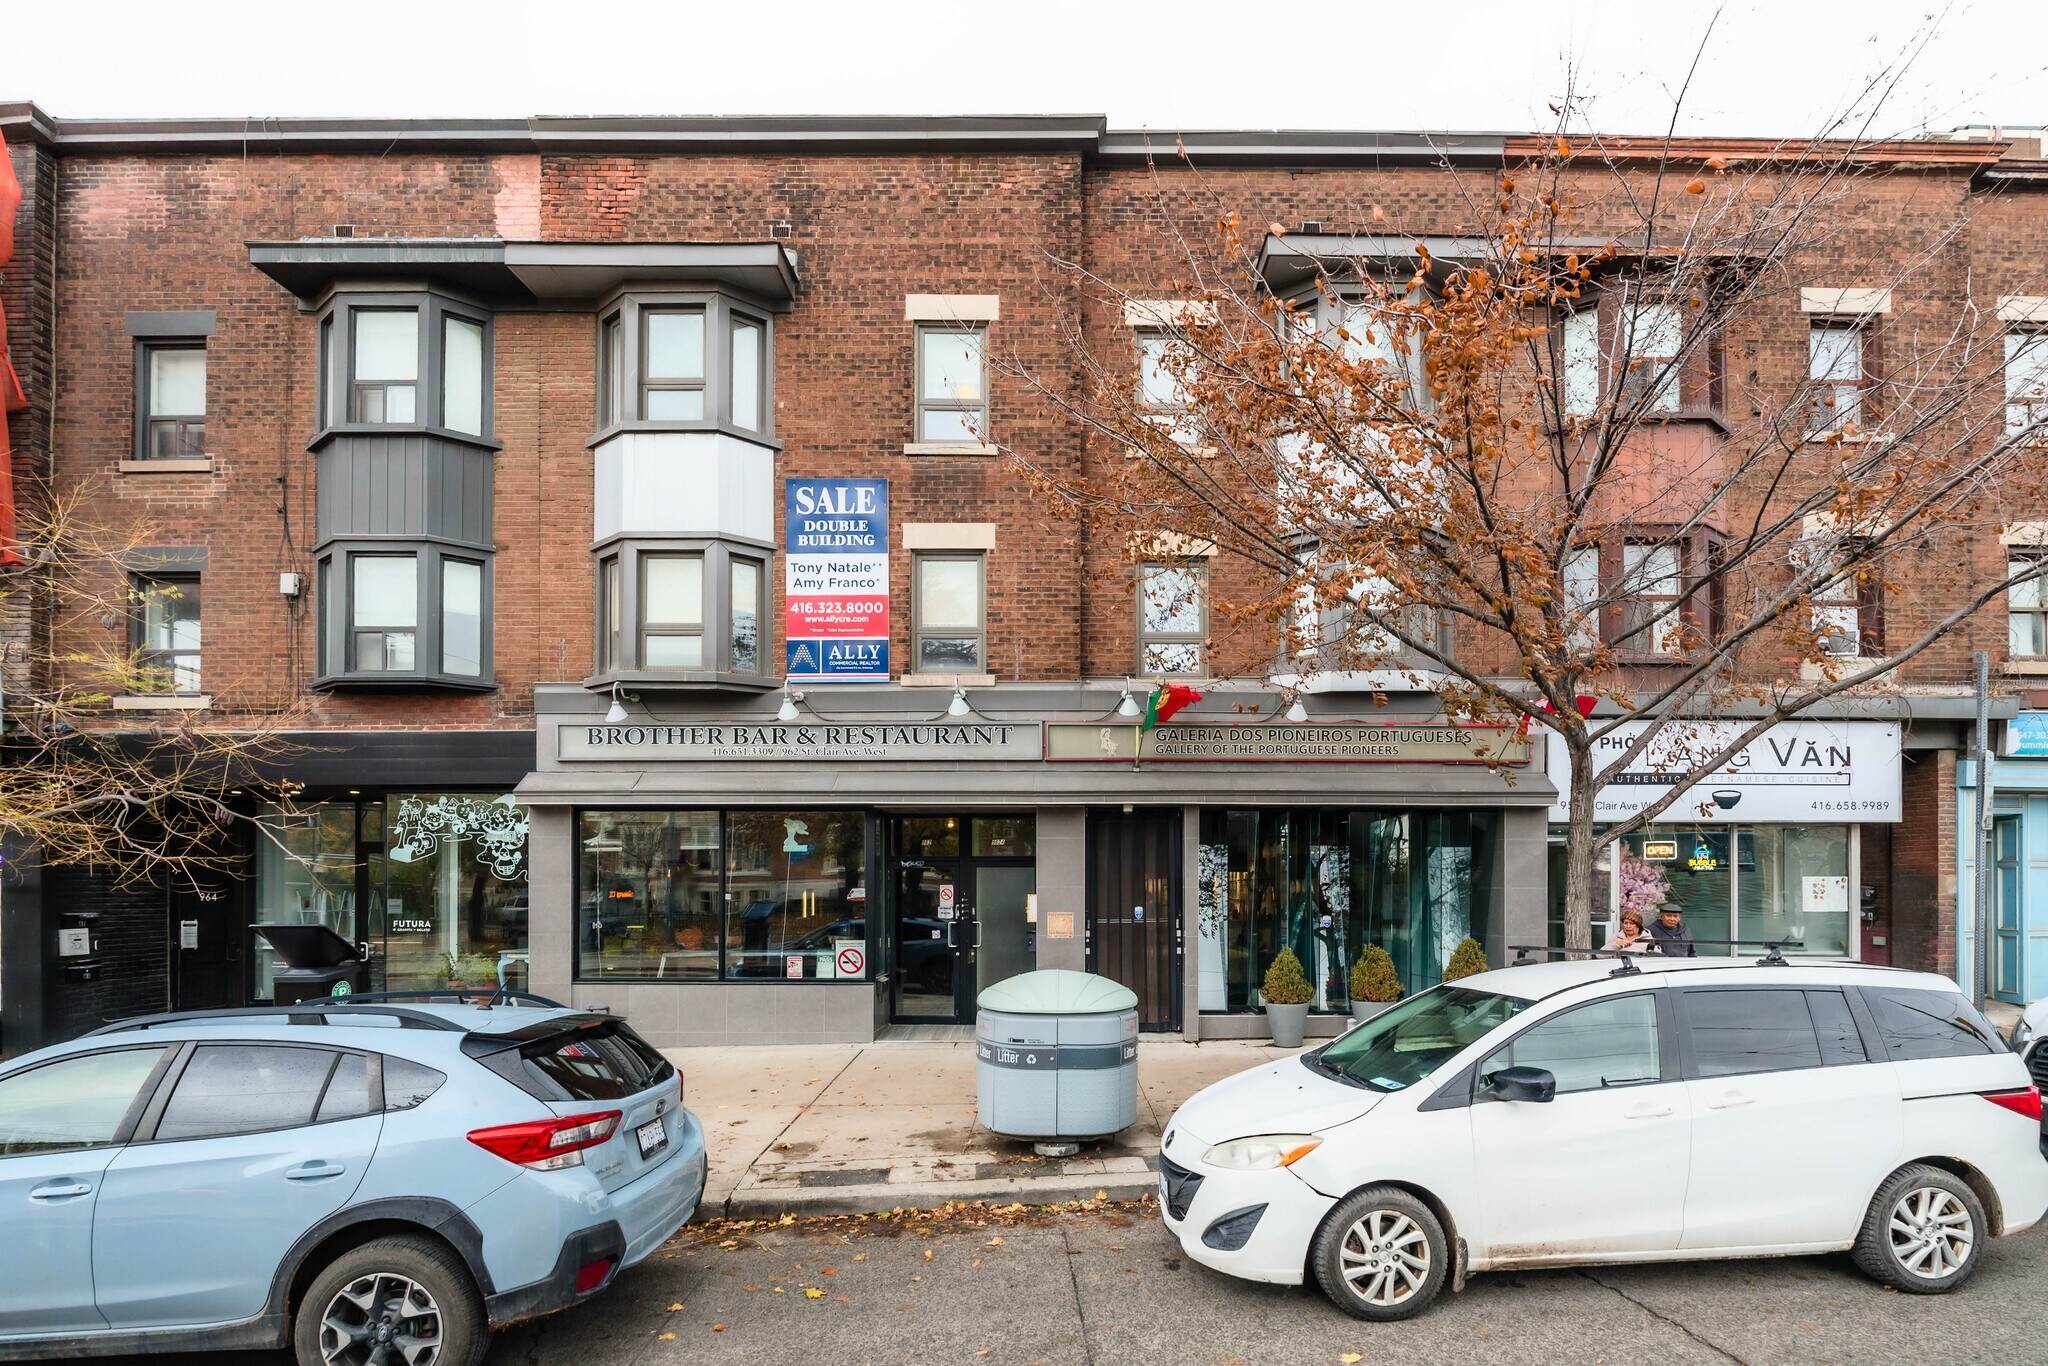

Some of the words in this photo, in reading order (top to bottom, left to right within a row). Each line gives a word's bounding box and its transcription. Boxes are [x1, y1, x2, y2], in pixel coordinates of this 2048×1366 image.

[795, 486, 876, 515] SALE
[804, 520, 868, 531] DOUBLE
[798, 534, 875, 546] BUILDING
[791, 562, 822, 574] Tony
[793, 578, 824, 589] Amy
[790, 602, 884, 614] 416.323.8000
[805, 615, 869, 624] www.allycre.com
[829, 645, 881, 659] ALLY
[587, 727, 724, 745] BROTHER
[733, 727, 789, 745] BAR
[796, 727, 817, 745] &
[824, 726, 1012, 745] RESTAURANT
[1155, 729, 1223, 742] GALERIA
[1229, 729, 1263, 742] DOS
[1268, 730, 1352, 743] PIONEIROS
[1358, 730, 1472, 743] PORTUGUESES
[712, 747, 774, 756] 416.651.3309
[781, 747, 798, 756] 962
[815, 747, 839, 756] Clair
[864, 747, 887, 756] West
[1155, 744, 1208, 754] GALLERY
[1212, 744, 1228, 754] OF
[1231, 744, 1255, 754] THE
[1258, 745, 1337, 755] PORTUGUESE
[1341, 745, 1399, 755] PIONEERS
[1768, 738, 1851, 766] VĂN
[1788, 775, 1840, 784] CUISINE
[1595, 801, 1617, 811] Clair
[1619, 801, 1638, 811] Ave
[1811, 801, 1890, 811] 416.658.9989
[1647, 846, 1674, 855] OPEN
[393, 920, 431, 928] FUTURA
[997, 1048, 1020, 1064] Litter
